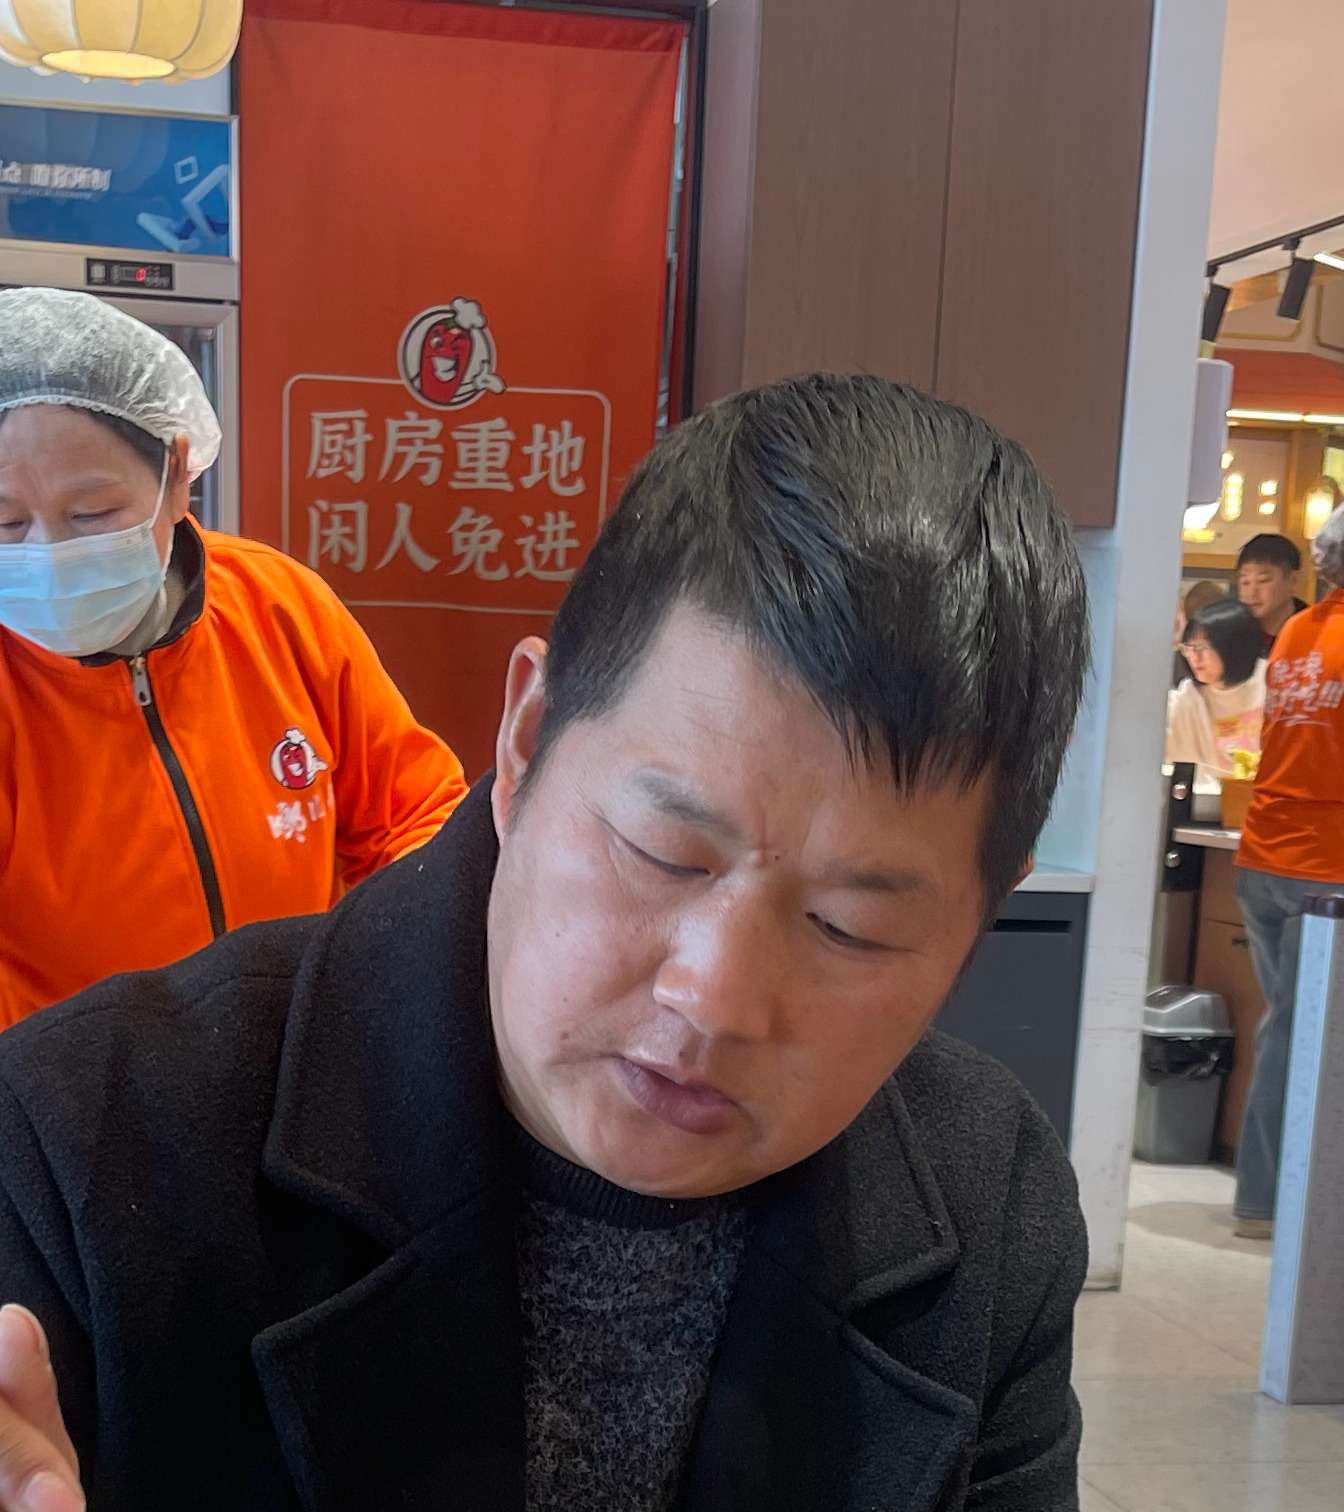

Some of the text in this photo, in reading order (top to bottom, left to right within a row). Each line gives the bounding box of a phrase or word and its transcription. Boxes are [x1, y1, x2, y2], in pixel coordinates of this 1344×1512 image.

[306, 408, 587, 496] 厨房重地
[307, 498, 581, 582] 闲人免进
